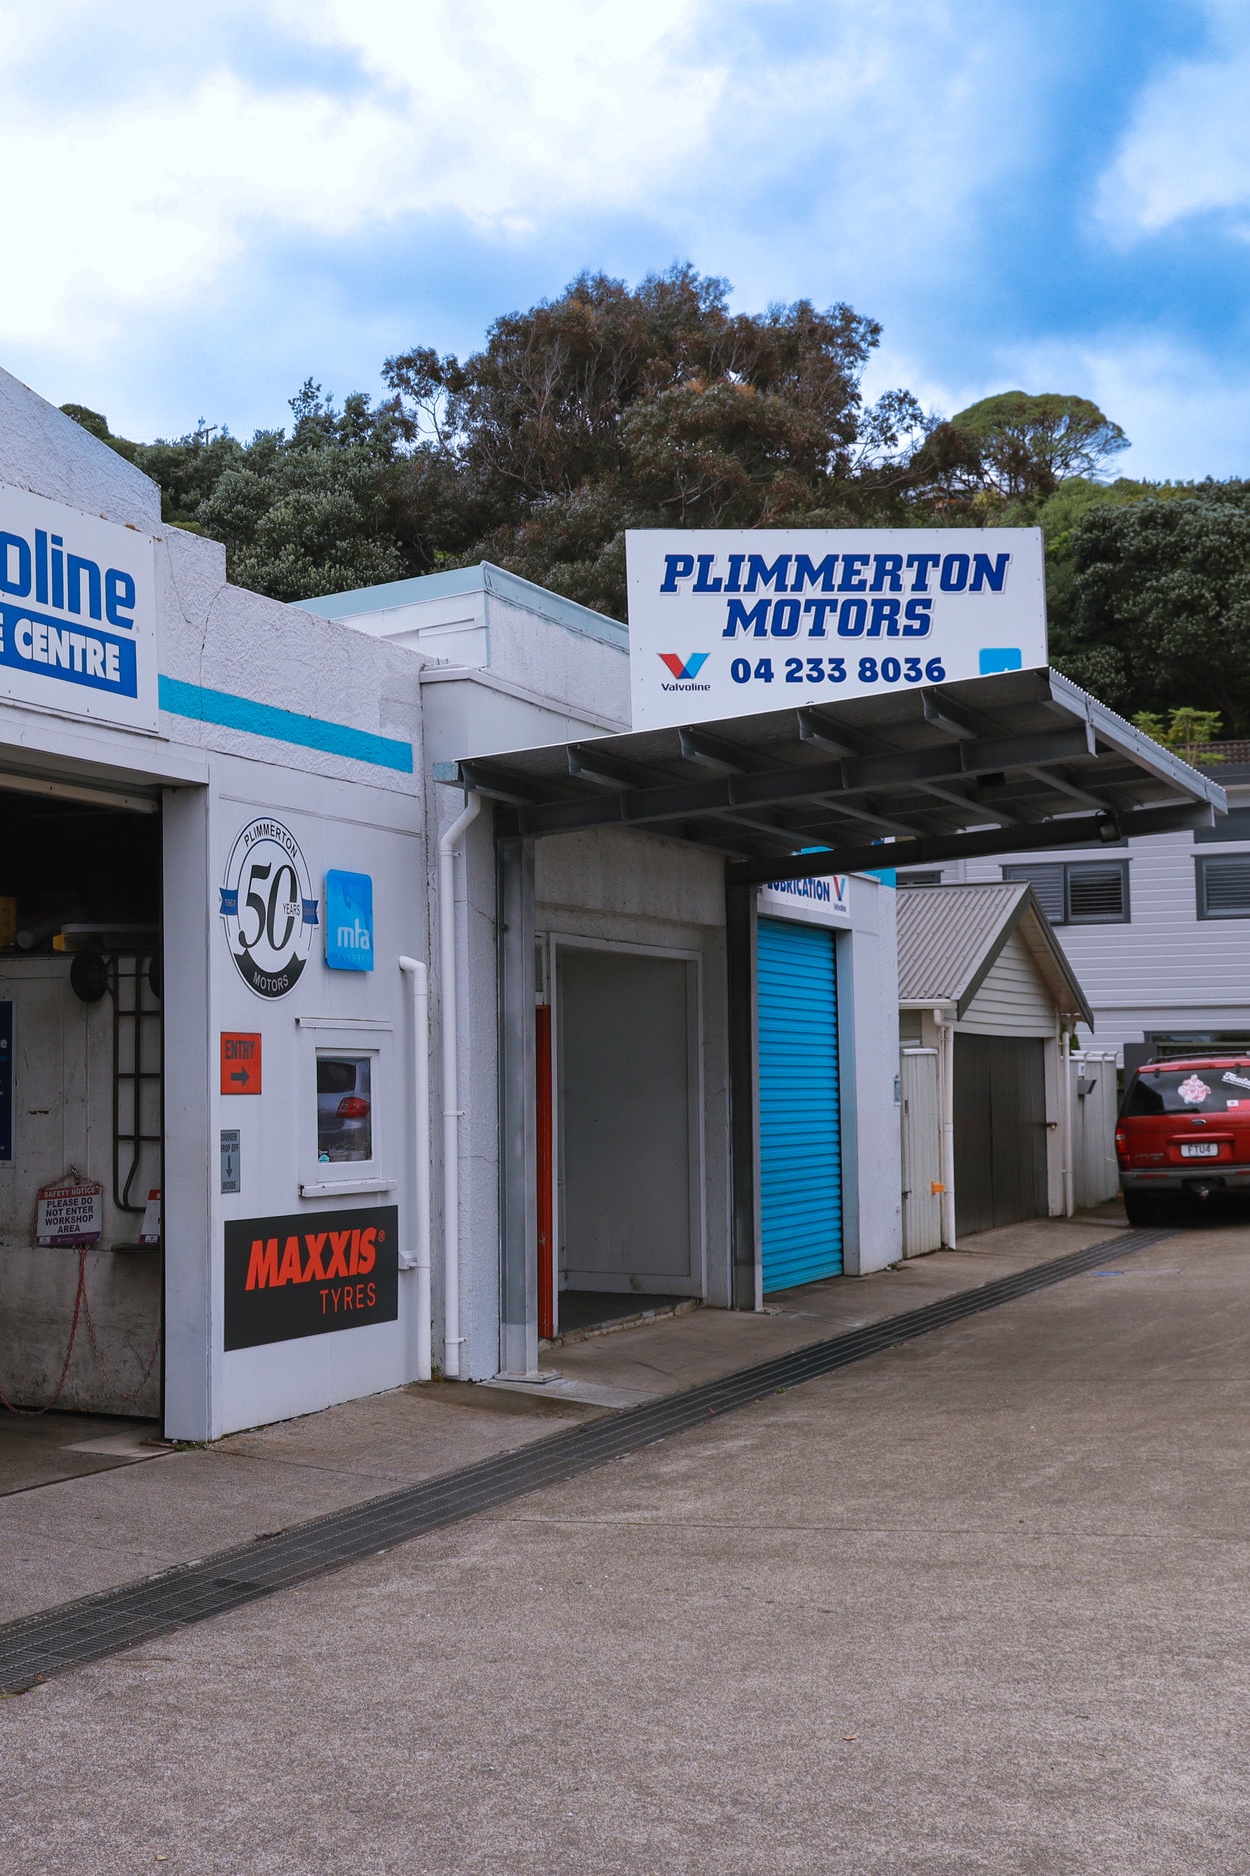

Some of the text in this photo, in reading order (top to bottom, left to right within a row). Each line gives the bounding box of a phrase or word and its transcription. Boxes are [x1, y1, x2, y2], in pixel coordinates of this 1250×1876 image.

[659, 553, 1010, 593] PLIMMERTON
[722, 598, 933, 638] MOTORS
[14, 618, 120, 683] CENTRE
[730, 656, 946, 684] 04 233 8036
[661, 683, 711, 692] Valvoline
[243, 824, 298, 858] PLIMMERTON
[238, 862, 298, 951] 50
[282, 902, 300, 916] YEARS
[338, 918, 371, 950] mta
[253, 973, 289, 991] MOTORS
[225, 1040, 255, 1060] ENTRY
[1188, 1144, 1211, 1154] FTU4
[44, 1187, 96, 1198] SAFETY NOTICE
[47, 1197, 93, 1208] PLEASE DO
[45, 1214, 94, 1226] WORKSHOP
[46, 1206, 93, 1217] NOT ENTER
[57, 1225, 80, 1233] AREA
[245, 1227, 377, 1291] MAXXIS
[319, 1282, 377, 1314] TYRES
